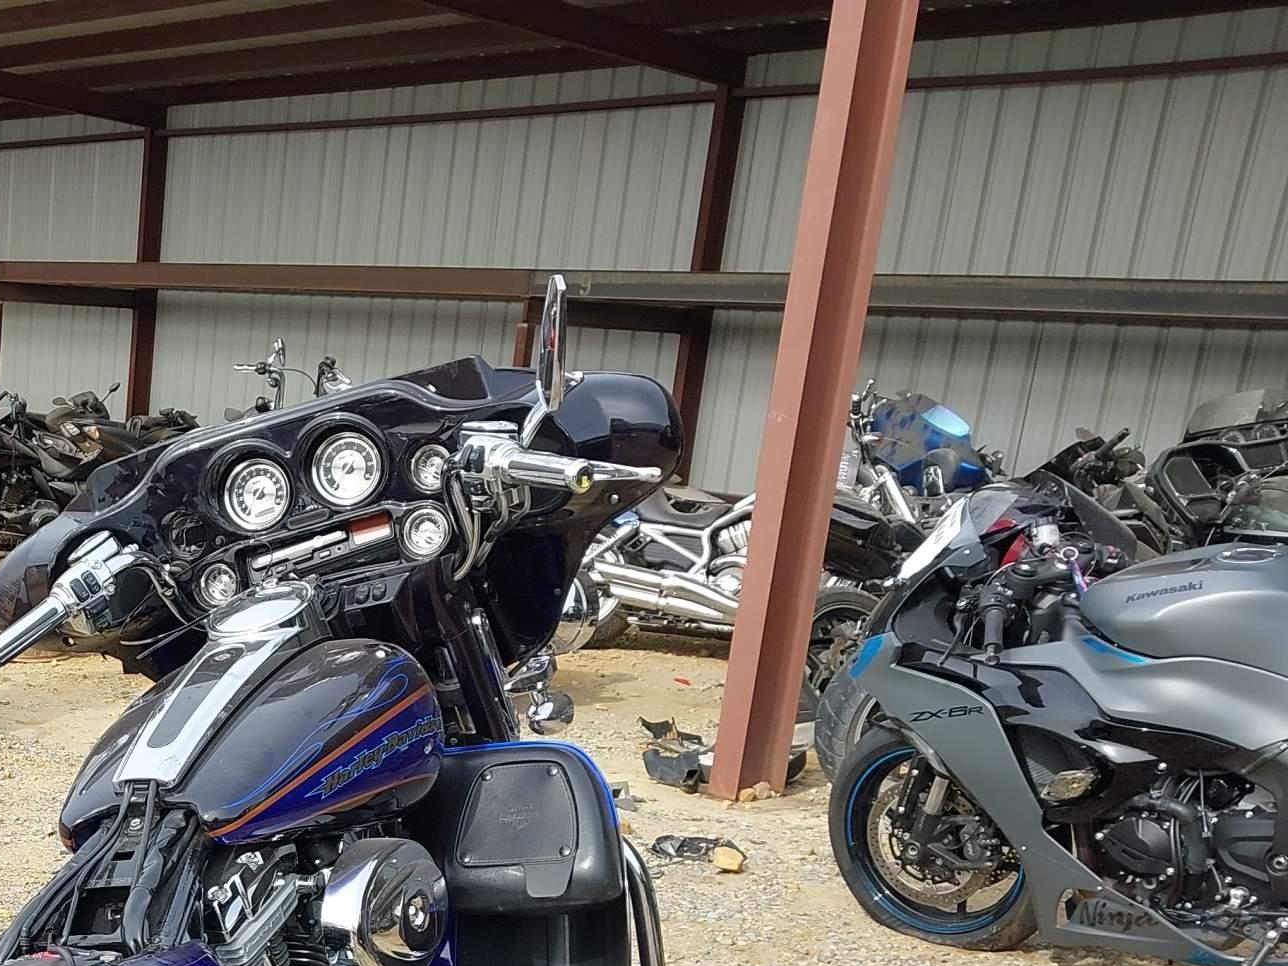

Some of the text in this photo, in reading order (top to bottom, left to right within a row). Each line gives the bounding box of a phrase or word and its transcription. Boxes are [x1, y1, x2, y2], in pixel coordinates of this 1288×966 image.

[1125, 580, 1204, 603] Kawasaki
[910, 706, 984, 722] ZX-6R
[1079, 901, 1160, 934] Ninja
